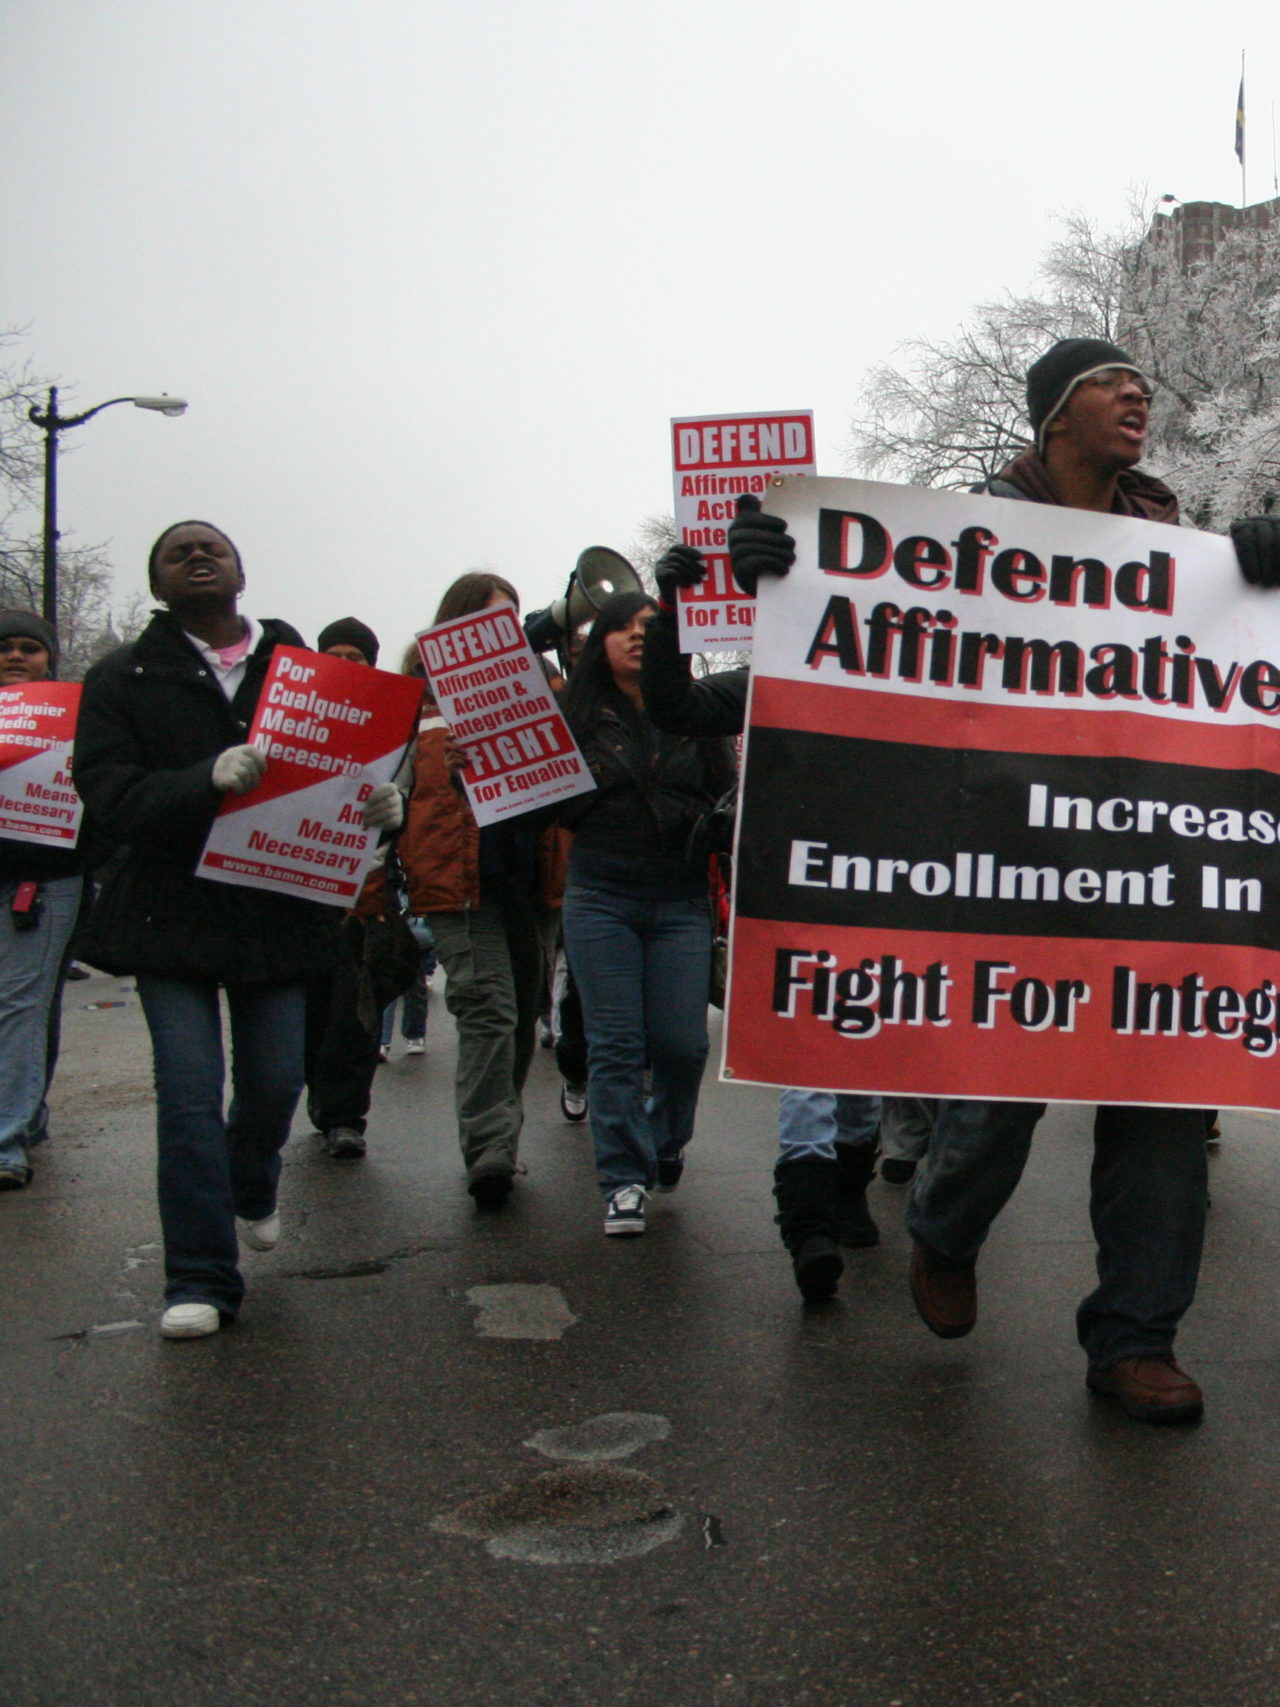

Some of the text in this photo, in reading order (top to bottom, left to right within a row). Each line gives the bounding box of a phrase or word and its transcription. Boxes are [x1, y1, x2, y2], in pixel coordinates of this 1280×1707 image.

[679, 422, 807, 465] DEFEND
[681, 470, 806, 497] Affirmat
[697, 500, 741, 521] Act
[818, 507, 1175, 617] Defend
[685, 607, 720, 627] for
[423, 615, 520, 672] DEFEND
[275, 656, 316, 684] Por
[436, 655, 530, 699] Affirmative
[267, 682, 373, 726] Cualquier
[453, 680, 529, 716] Action &
[259, 707, 331, 744] Medio
[253, 732, 364, 779] Necesario
[466, 720, 562, 777] FIGHT
[25, 782, 79, 805] Means
[357, 784, 374, 803] B
[473, 780, 503, 804] for
[504, 757, 581, 794] Equality
[297, 818, 369, 851] Means
[337, 804, 371, 832] An
[247, 829, 362, 876] Necessary
[222, 858, 340, 893] www.bamn.com
[788, 839, 1175, 907] Enrollment
[1200, 864, 1263, 913] In
[772, 946, 953, 1039] Fight
[971, 959, 1091, 1032] For
